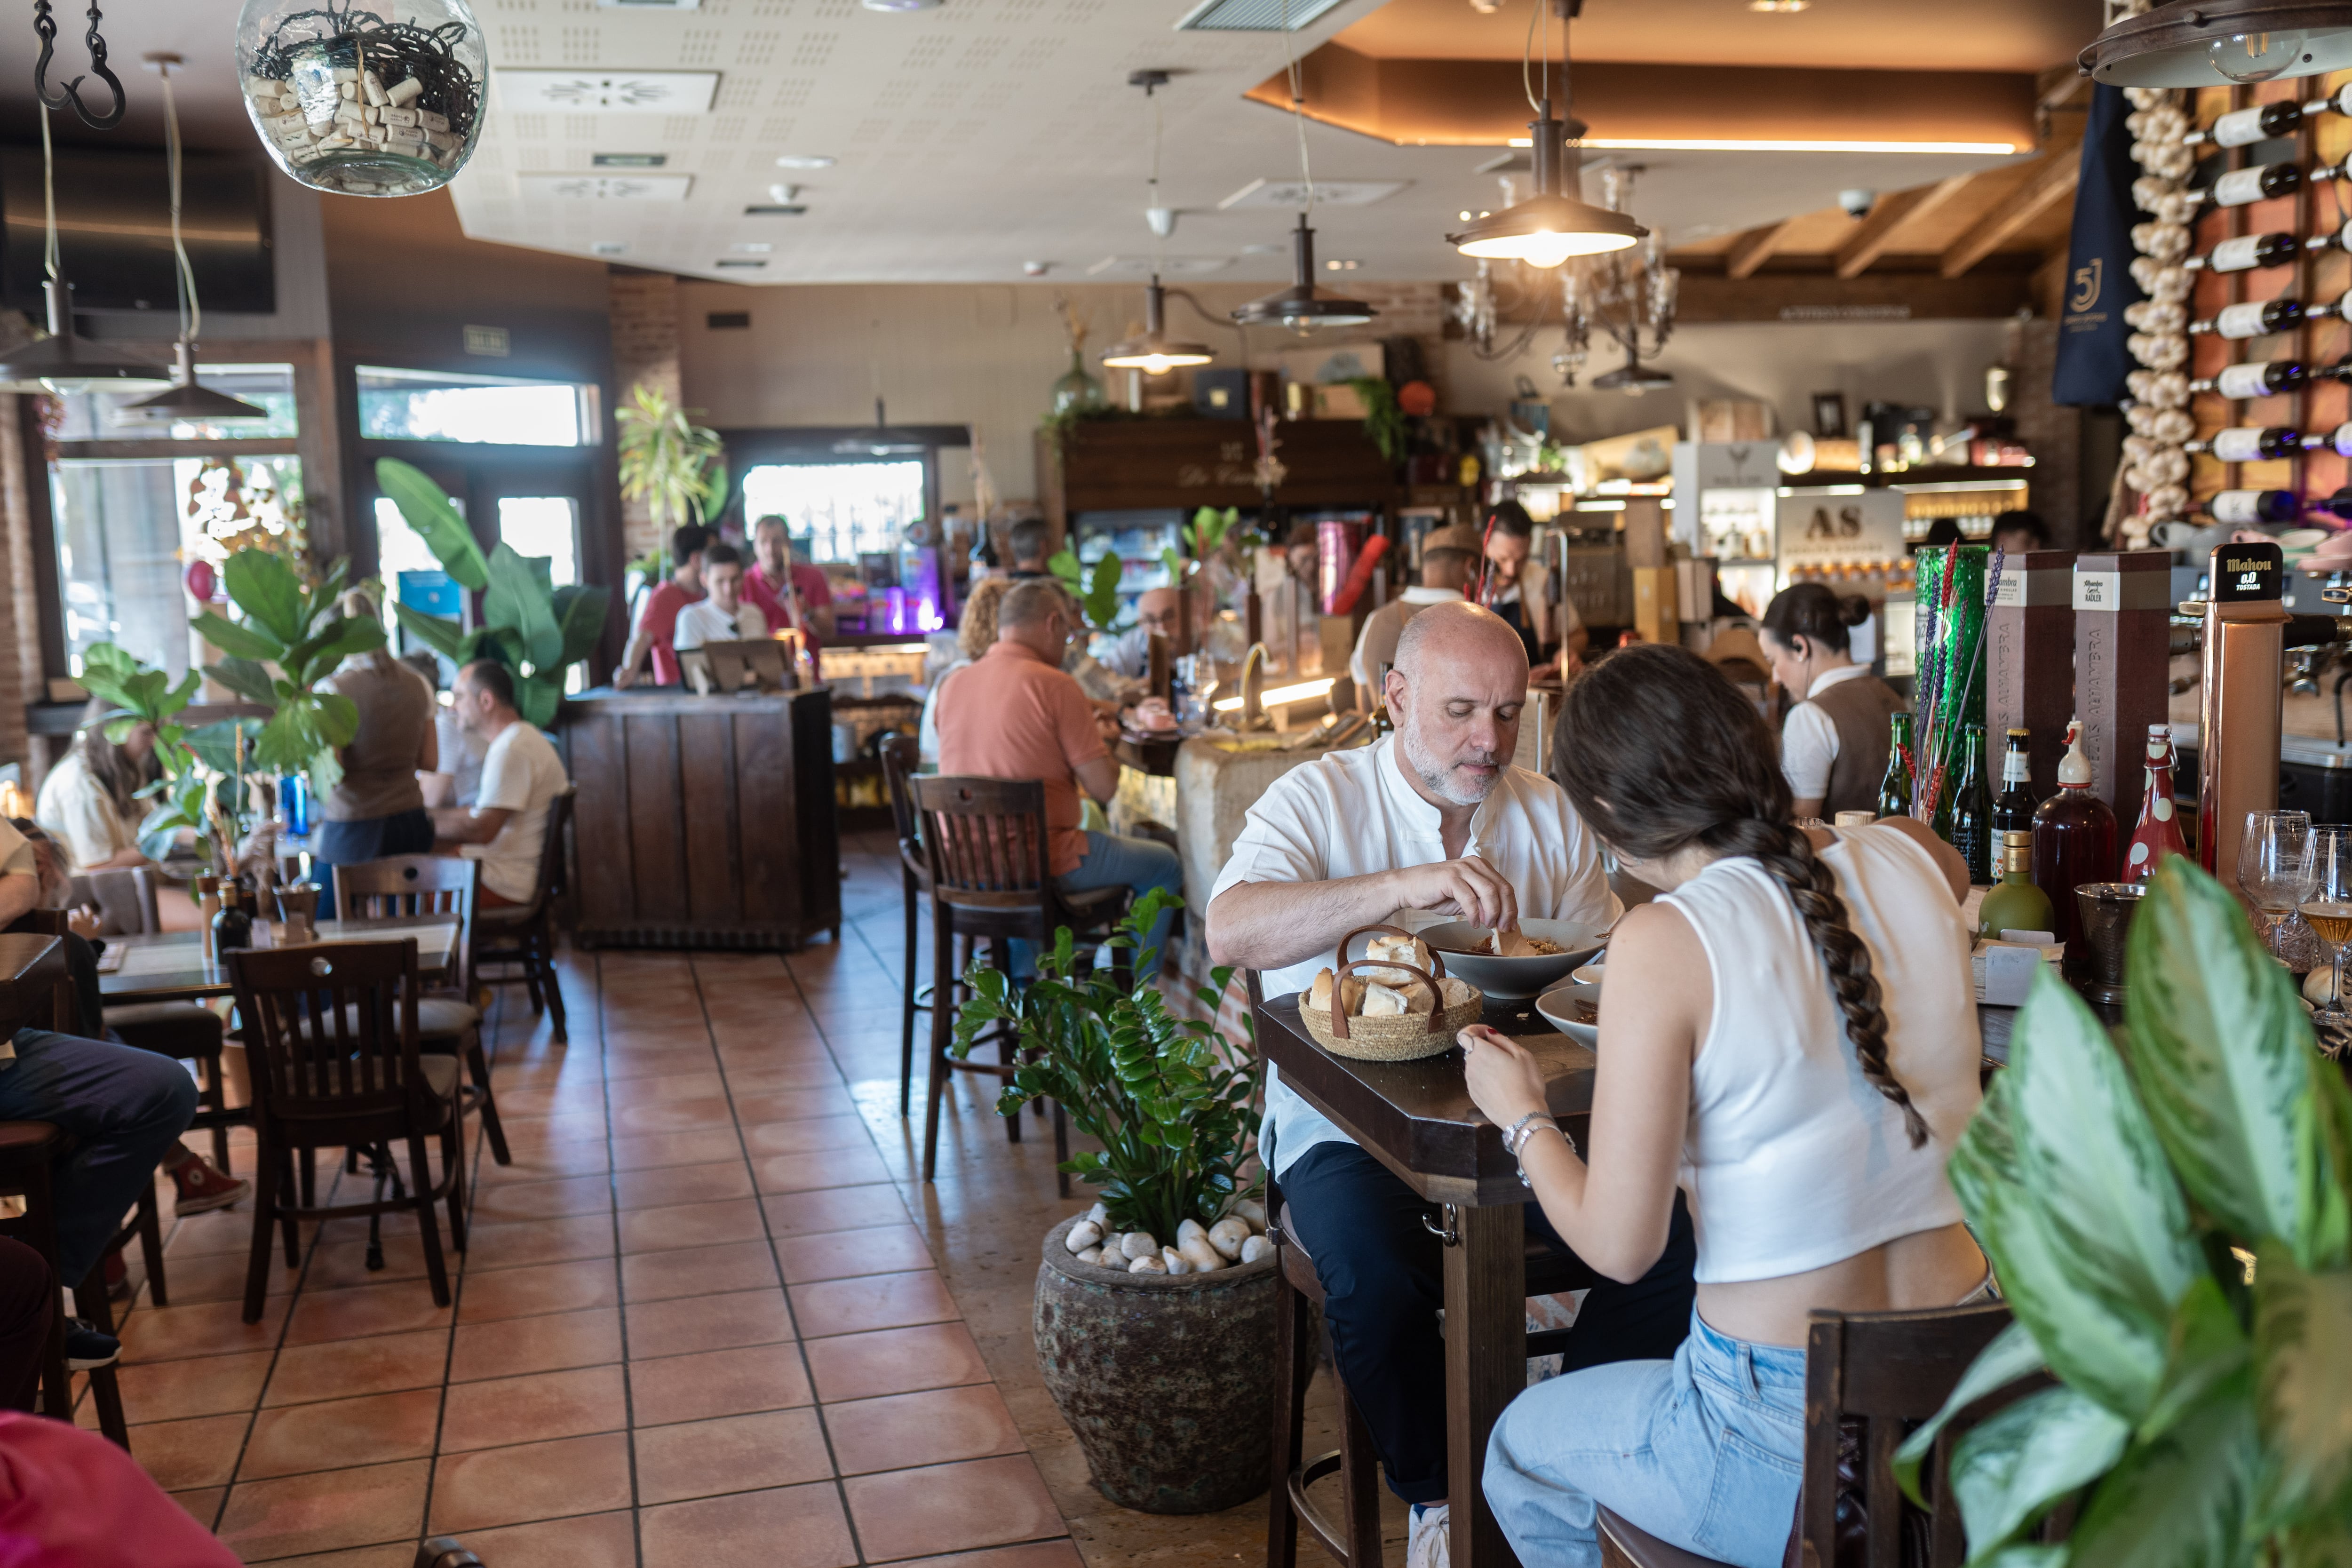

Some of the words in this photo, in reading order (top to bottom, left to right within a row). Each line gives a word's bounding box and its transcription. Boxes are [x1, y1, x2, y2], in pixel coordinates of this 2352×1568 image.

[2226, 557, 2272, 572] Mahou
[1999, 576, 2017, 587] ambra
[2241, 571, 2257, 584] 0,0
[1998, 622, 2010, 706] ALHAMBRA
[2089, 629, 2101, 714] ALHAMBRA
